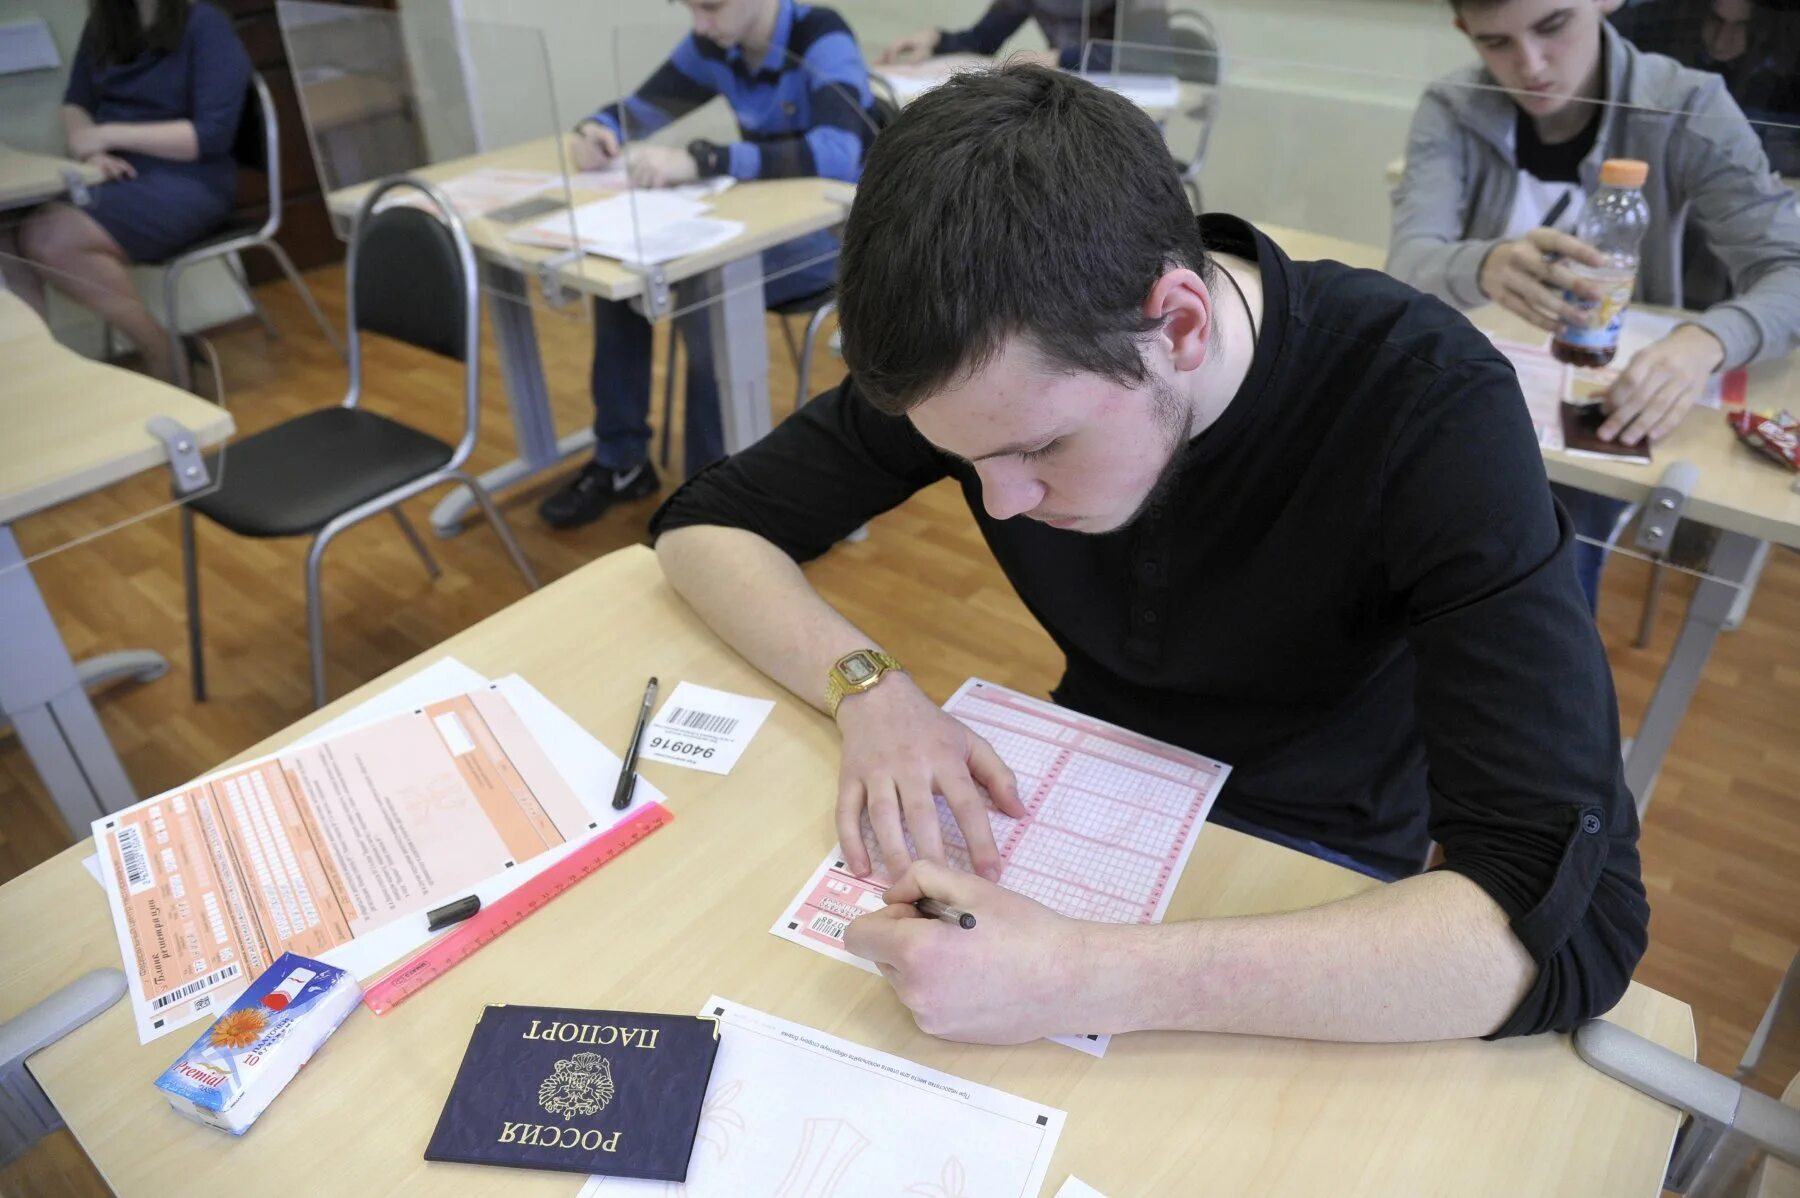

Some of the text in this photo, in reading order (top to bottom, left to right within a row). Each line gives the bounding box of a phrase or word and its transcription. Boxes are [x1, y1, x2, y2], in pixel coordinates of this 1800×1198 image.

[648, 734, 715, 762] 940916
[145, 896, 172, 960] регистрации
[129, 927, 148, 977] Федеральный
[147, 951, 166, 986] Бланк
[523, 1020, 659, 1048] ПАСПОРТ
[780, 1030, 798, 1041] бланка
[799, 1035, 819, 1048] сторону
[819, 1043, 848, 1058] оборотную
[242, 1054, 260, 1066] 10
[847, 1052, 880, 1068] используйте
[173, 1061, 226, 1087] Premial
[880, 1064, 899, 1075] ответа
[899, 1070, 910, 1078] для
[910, 1074, 926, 1084] места
[958, 1090, 970, 1100] При
[498, 1121, 622, 1153] РОССИЯ
